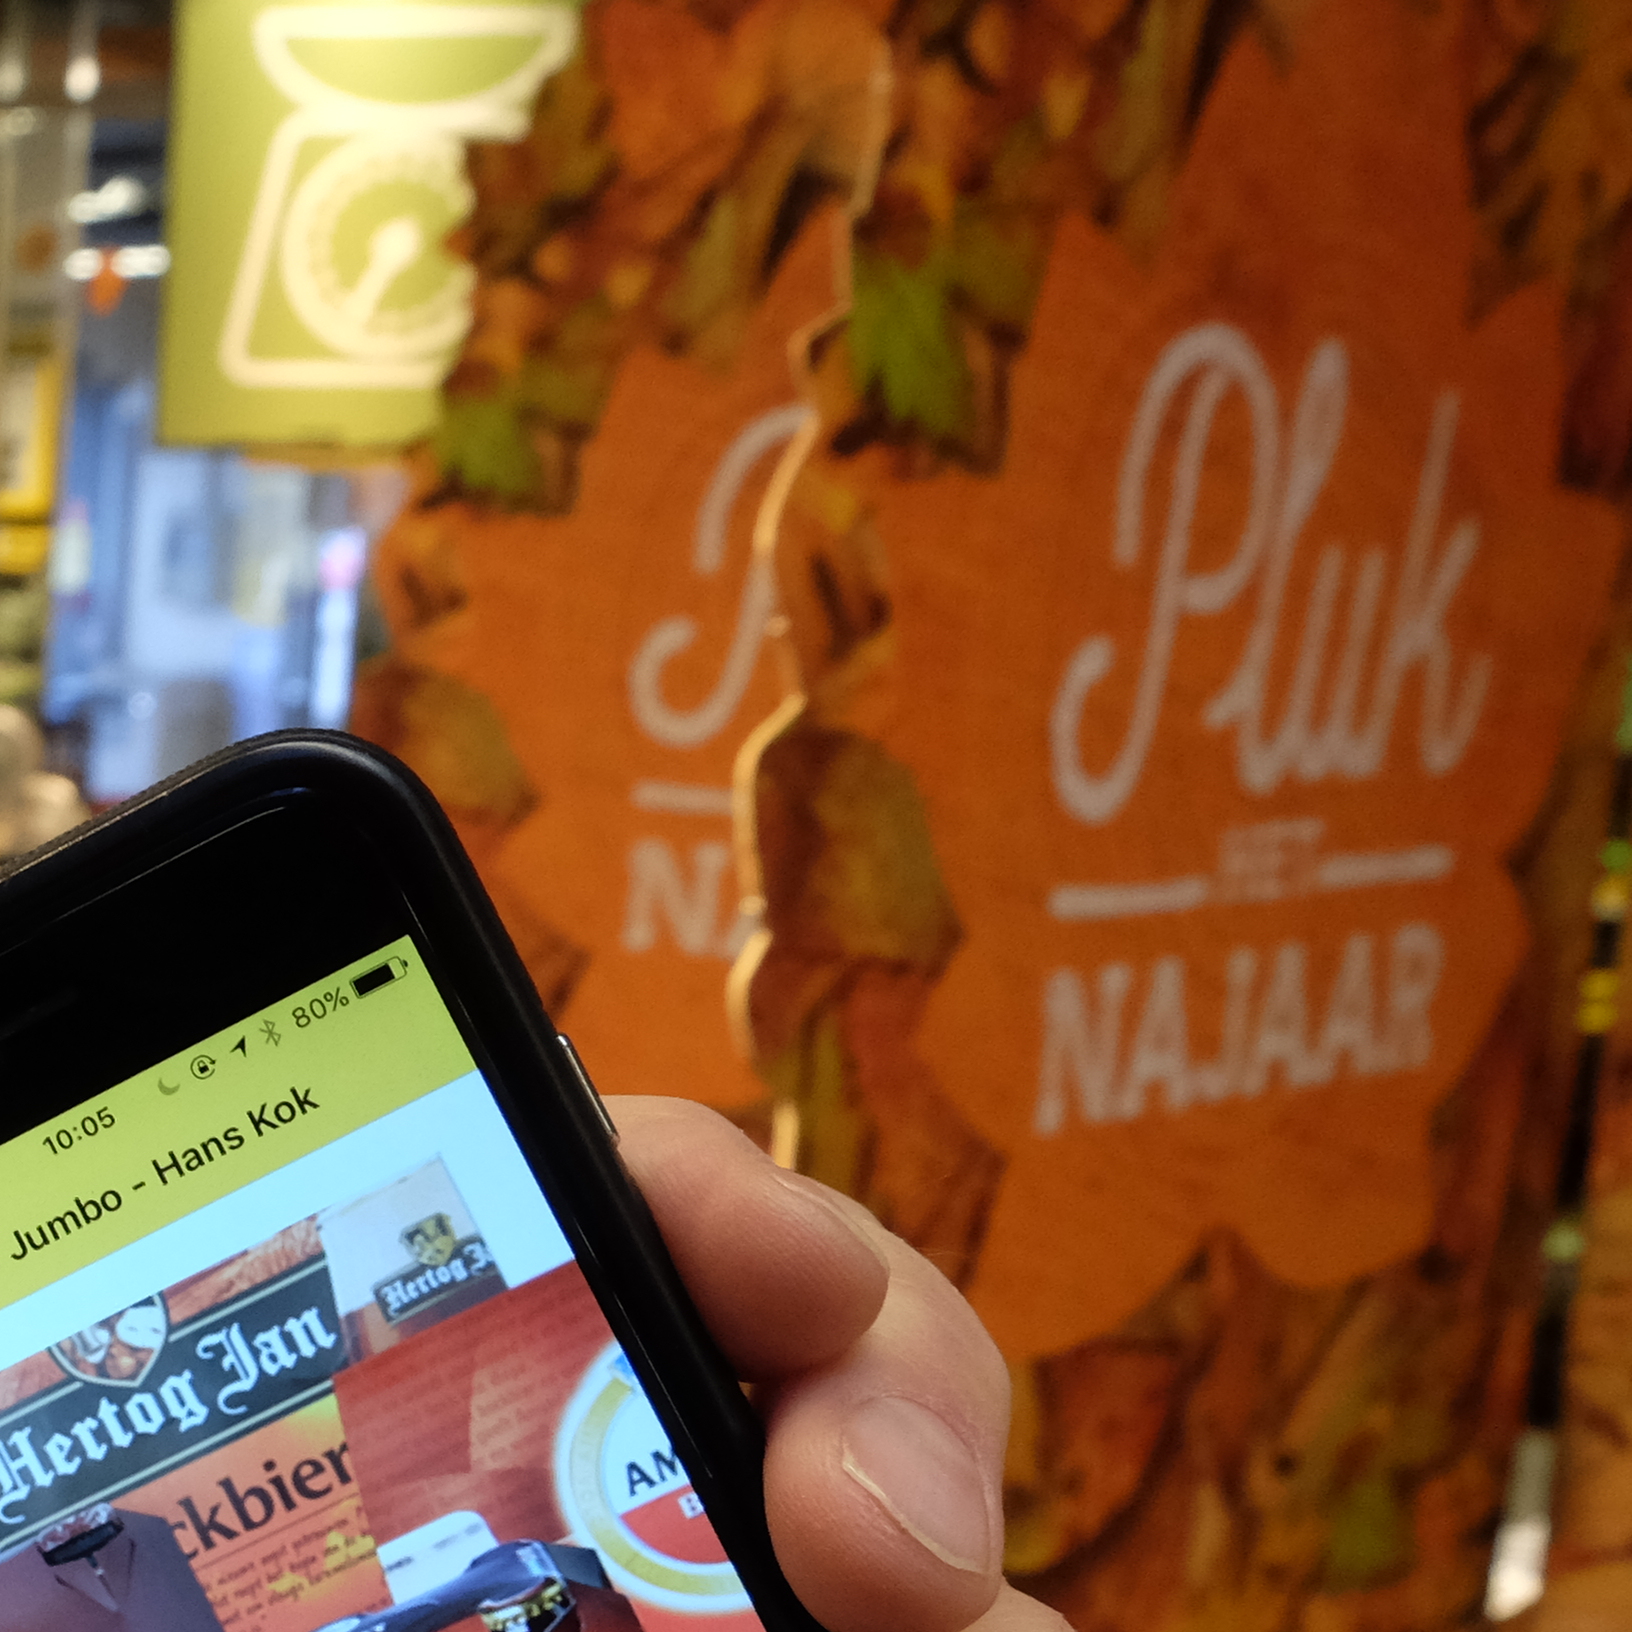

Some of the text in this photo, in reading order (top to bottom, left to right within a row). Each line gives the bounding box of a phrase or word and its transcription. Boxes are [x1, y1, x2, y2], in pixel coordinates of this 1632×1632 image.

[1050, 322, 1494, 824] Pluk
[42, 1106, 116, 1155] 10:05
[291, 986, 350, 1029] 80%
[1034, 920, 1448, 1137] NAJAAR
[10, 1189, 123, 1261] Jumbo
[151, 1126, 245, 1186] Hans
[247, 1086, 321, 1138] Kok
[195, 1304, 338, 1417] Jan
[379, 1242, 497, 1317] Hertog J
